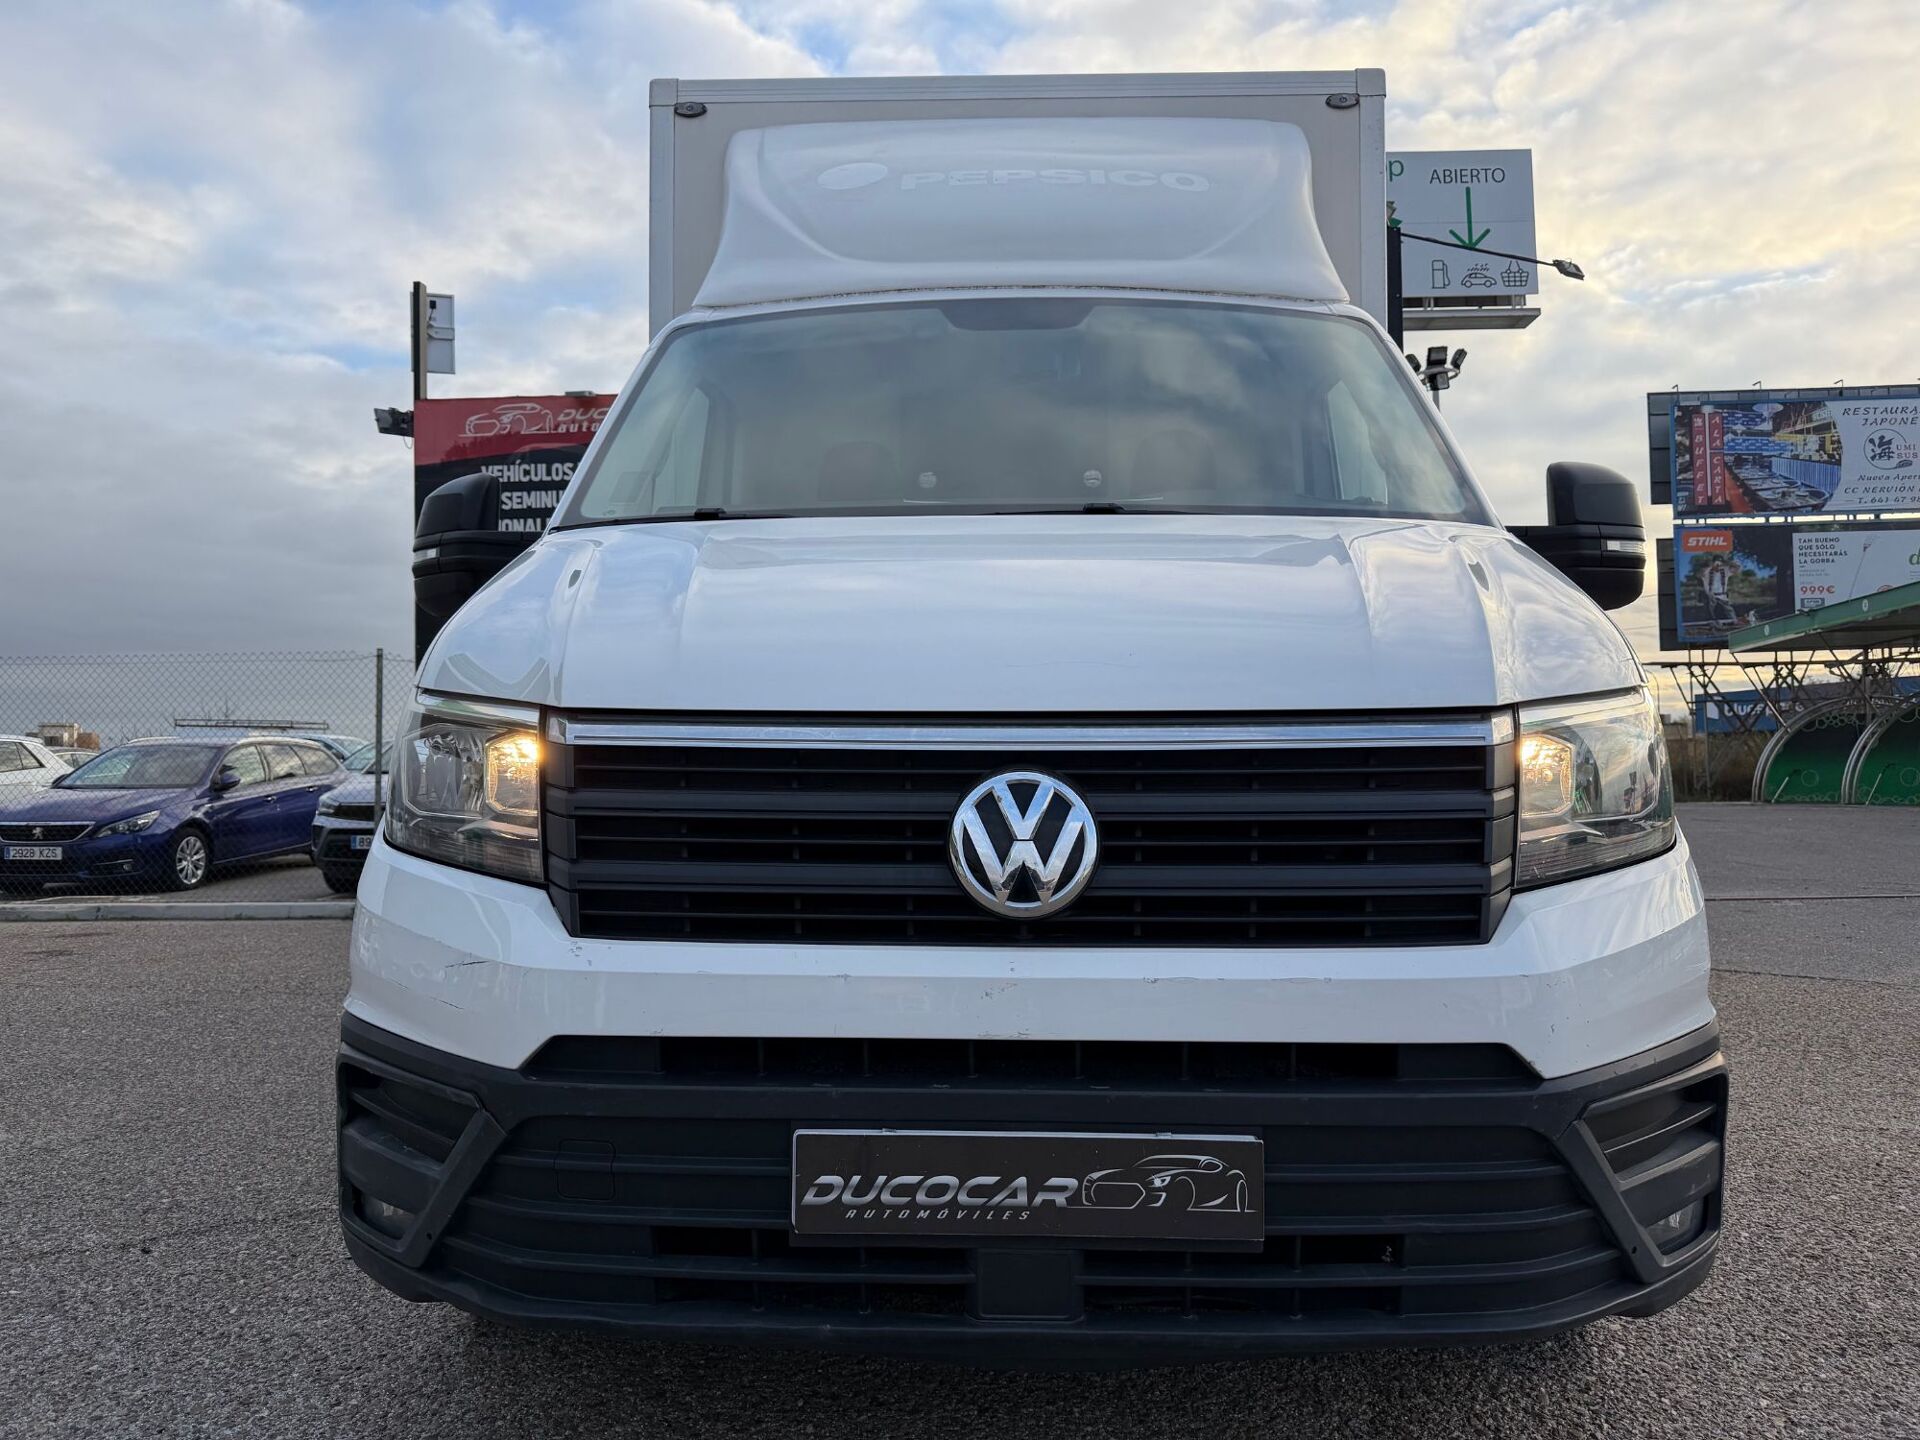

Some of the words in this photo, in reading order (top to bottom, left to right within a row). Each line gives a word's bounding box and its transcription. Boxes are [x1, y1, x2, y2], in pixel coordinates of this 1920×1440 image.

[901, 168, 1210, 191] PEPSICO
[1430, 167, 1506, 184] ABIERTO
[1842, 406, 1920, 416] RESTAURA
[1687, 536, 1727, 546] STIHL
[1800, 585, 1835, 595] 999€
[12, 848, 35, 858] 2928
[801, 1175, 1079, 1208] DUCOCAR
[845, 1208, 1031, 1220] AUTOMÓVILES
